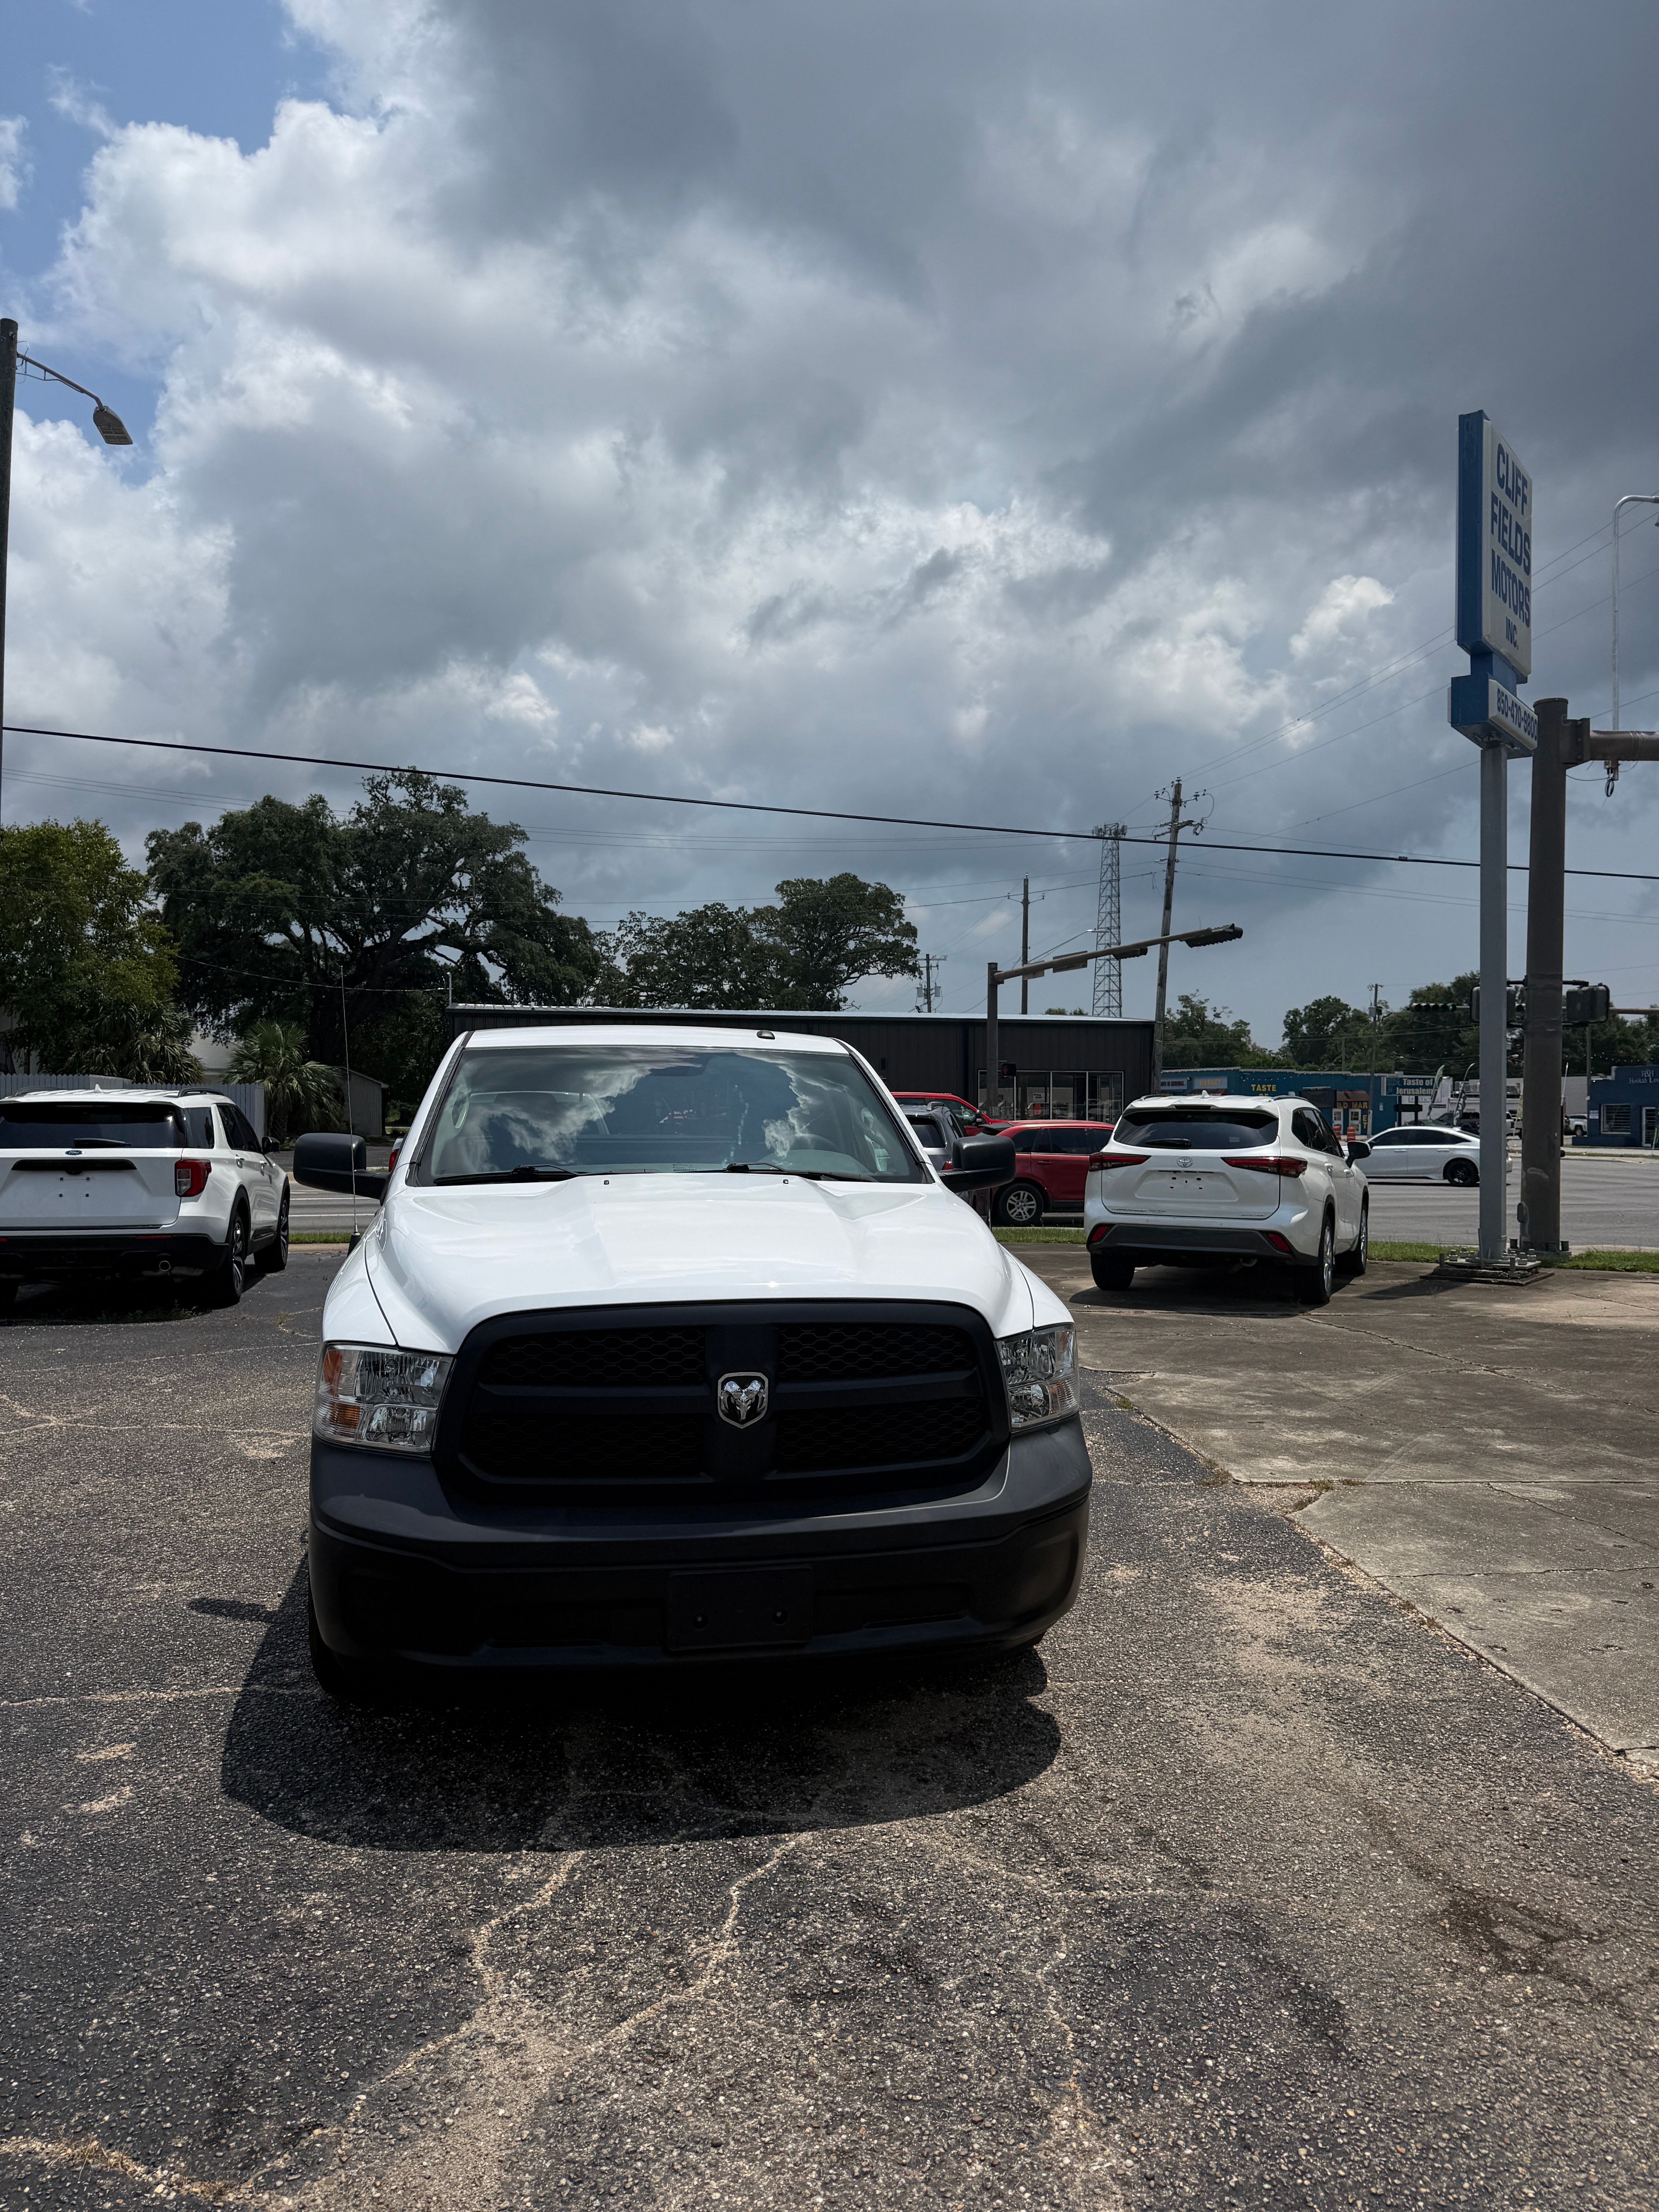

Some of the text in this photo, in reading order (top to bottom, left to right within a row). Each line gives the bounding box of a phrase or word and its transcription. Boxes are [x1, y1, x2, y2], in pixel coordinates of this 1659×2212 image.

[1497, 443, 1528, 516] CLIFF
[1491, 490, 1530, 576] FIELDS
[1491, 548, 1530, 628] MOTORS
[1506, 617, 1519, 651] INC.
[1497, 688, 1537, 741] 850-470-9800
